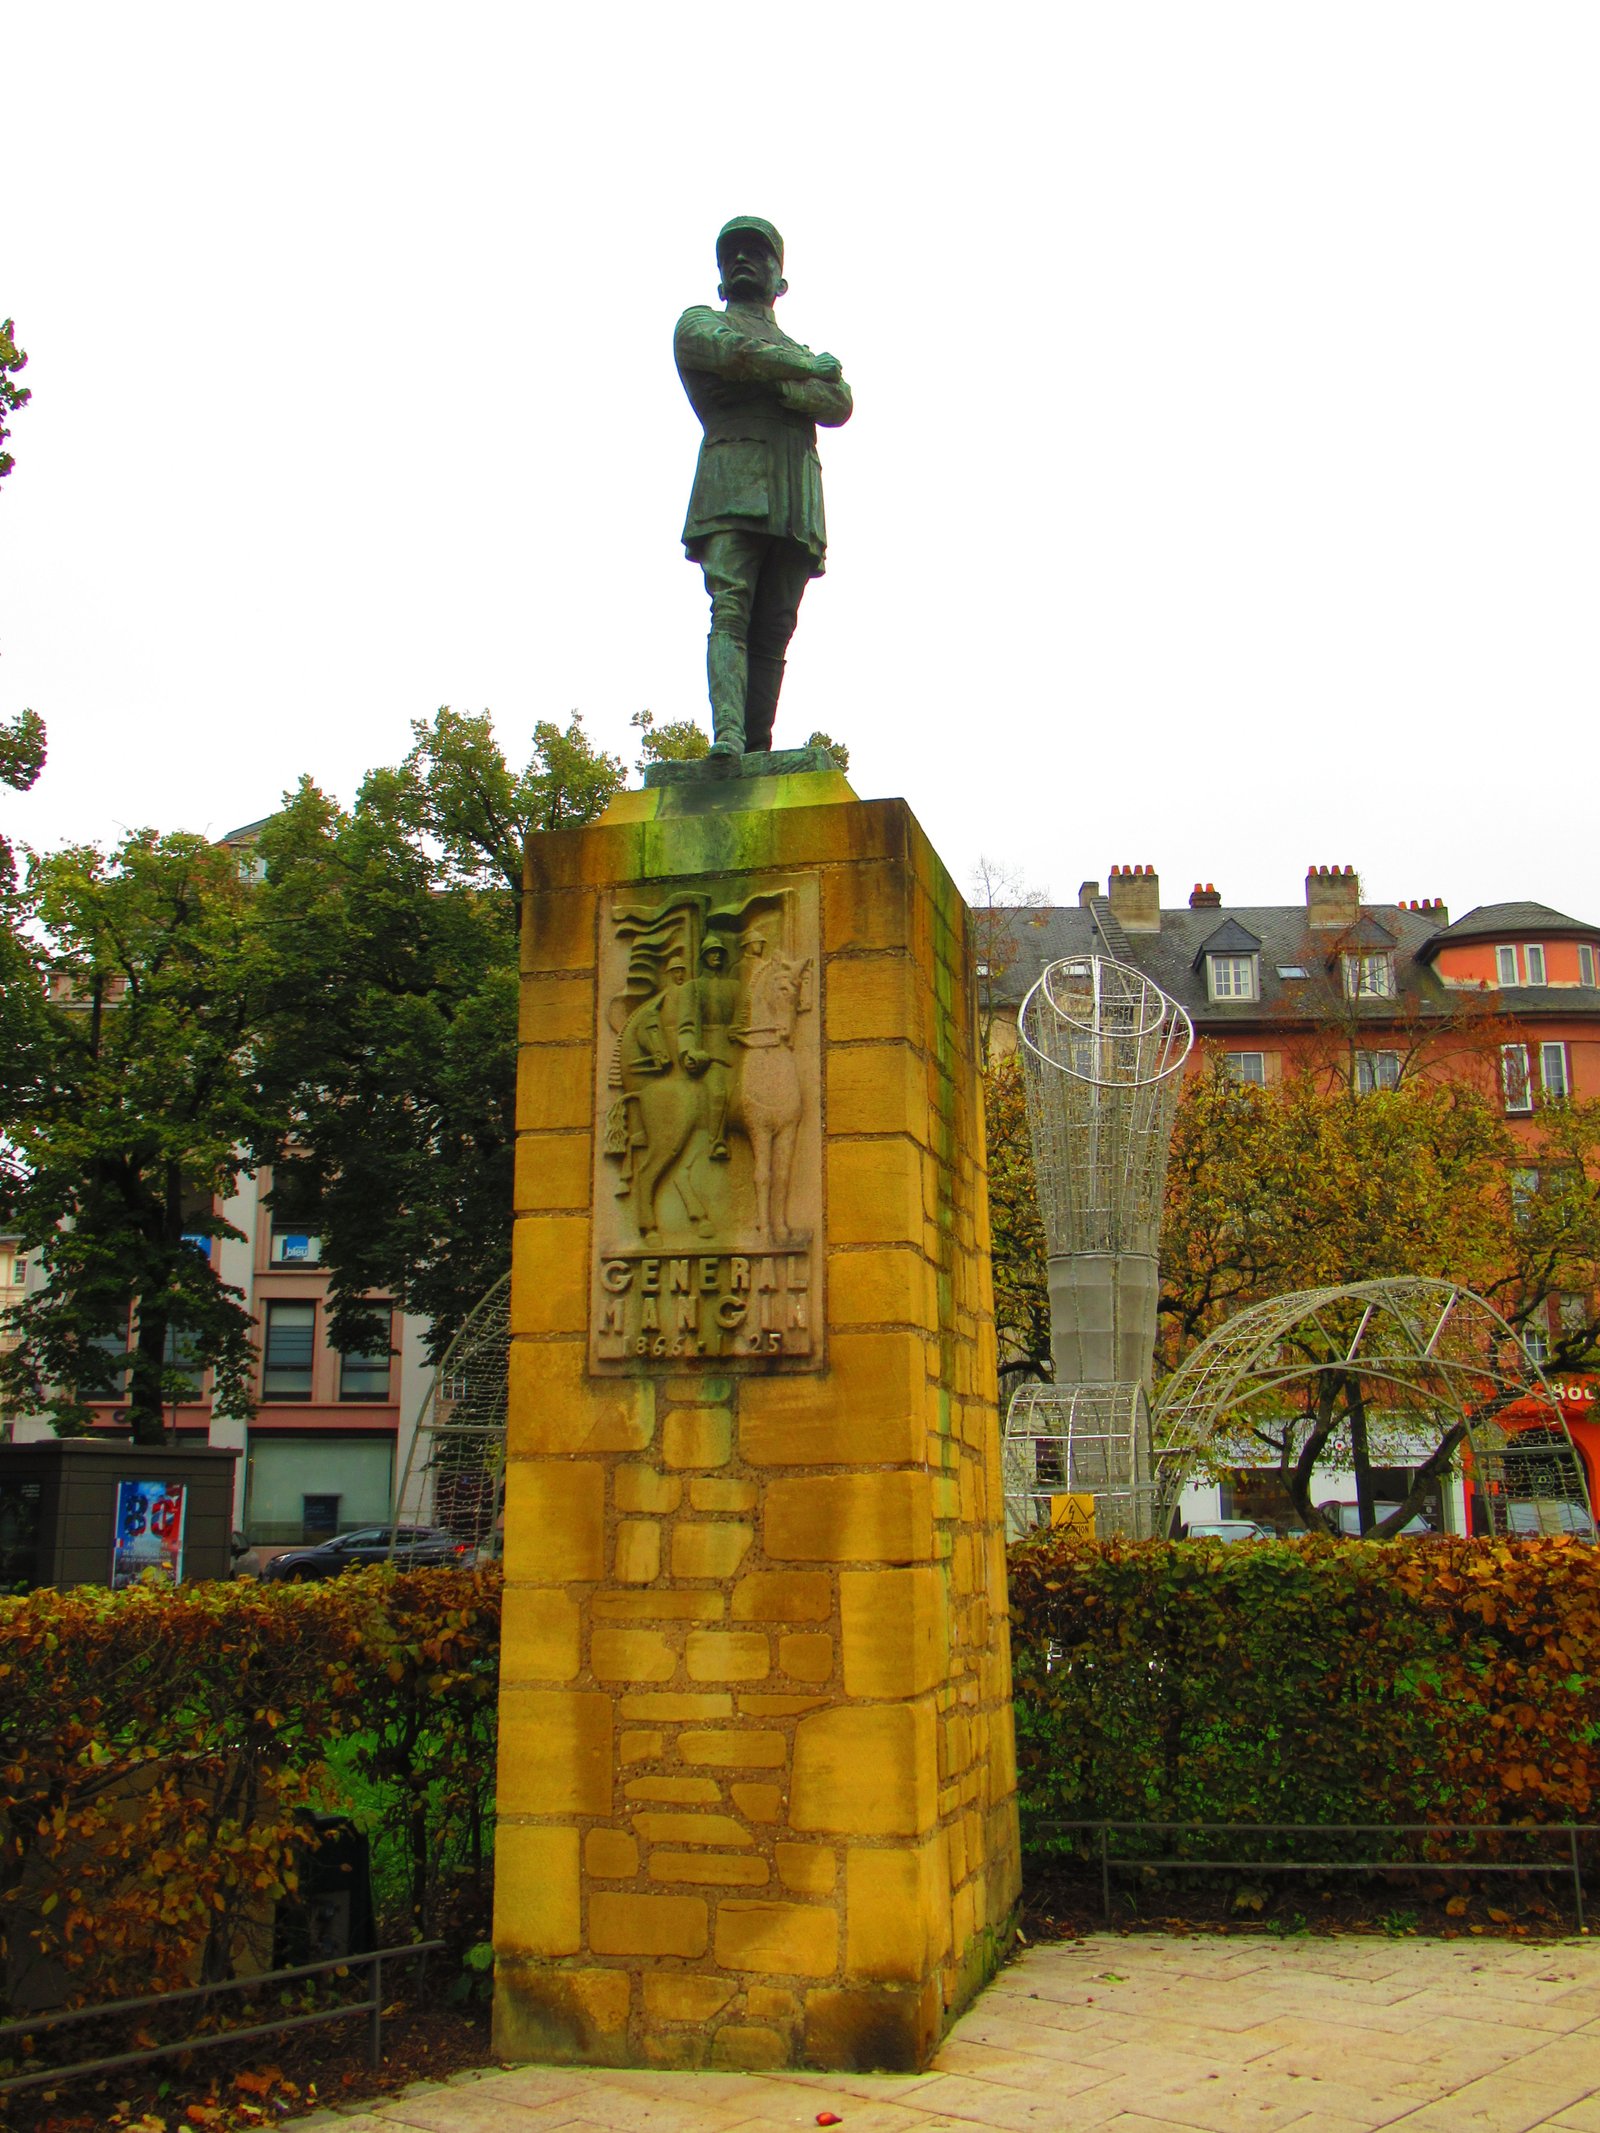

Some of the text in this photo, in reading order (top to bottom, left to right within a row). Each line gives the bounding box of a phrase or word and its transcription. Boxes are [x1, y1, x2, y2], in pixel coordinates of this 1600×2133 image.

[287, 1246, 308, 1257] bleu
[602, 1257, 808, 1293] GENERAL
[598, 1293, 807, 1334] MANGIN
